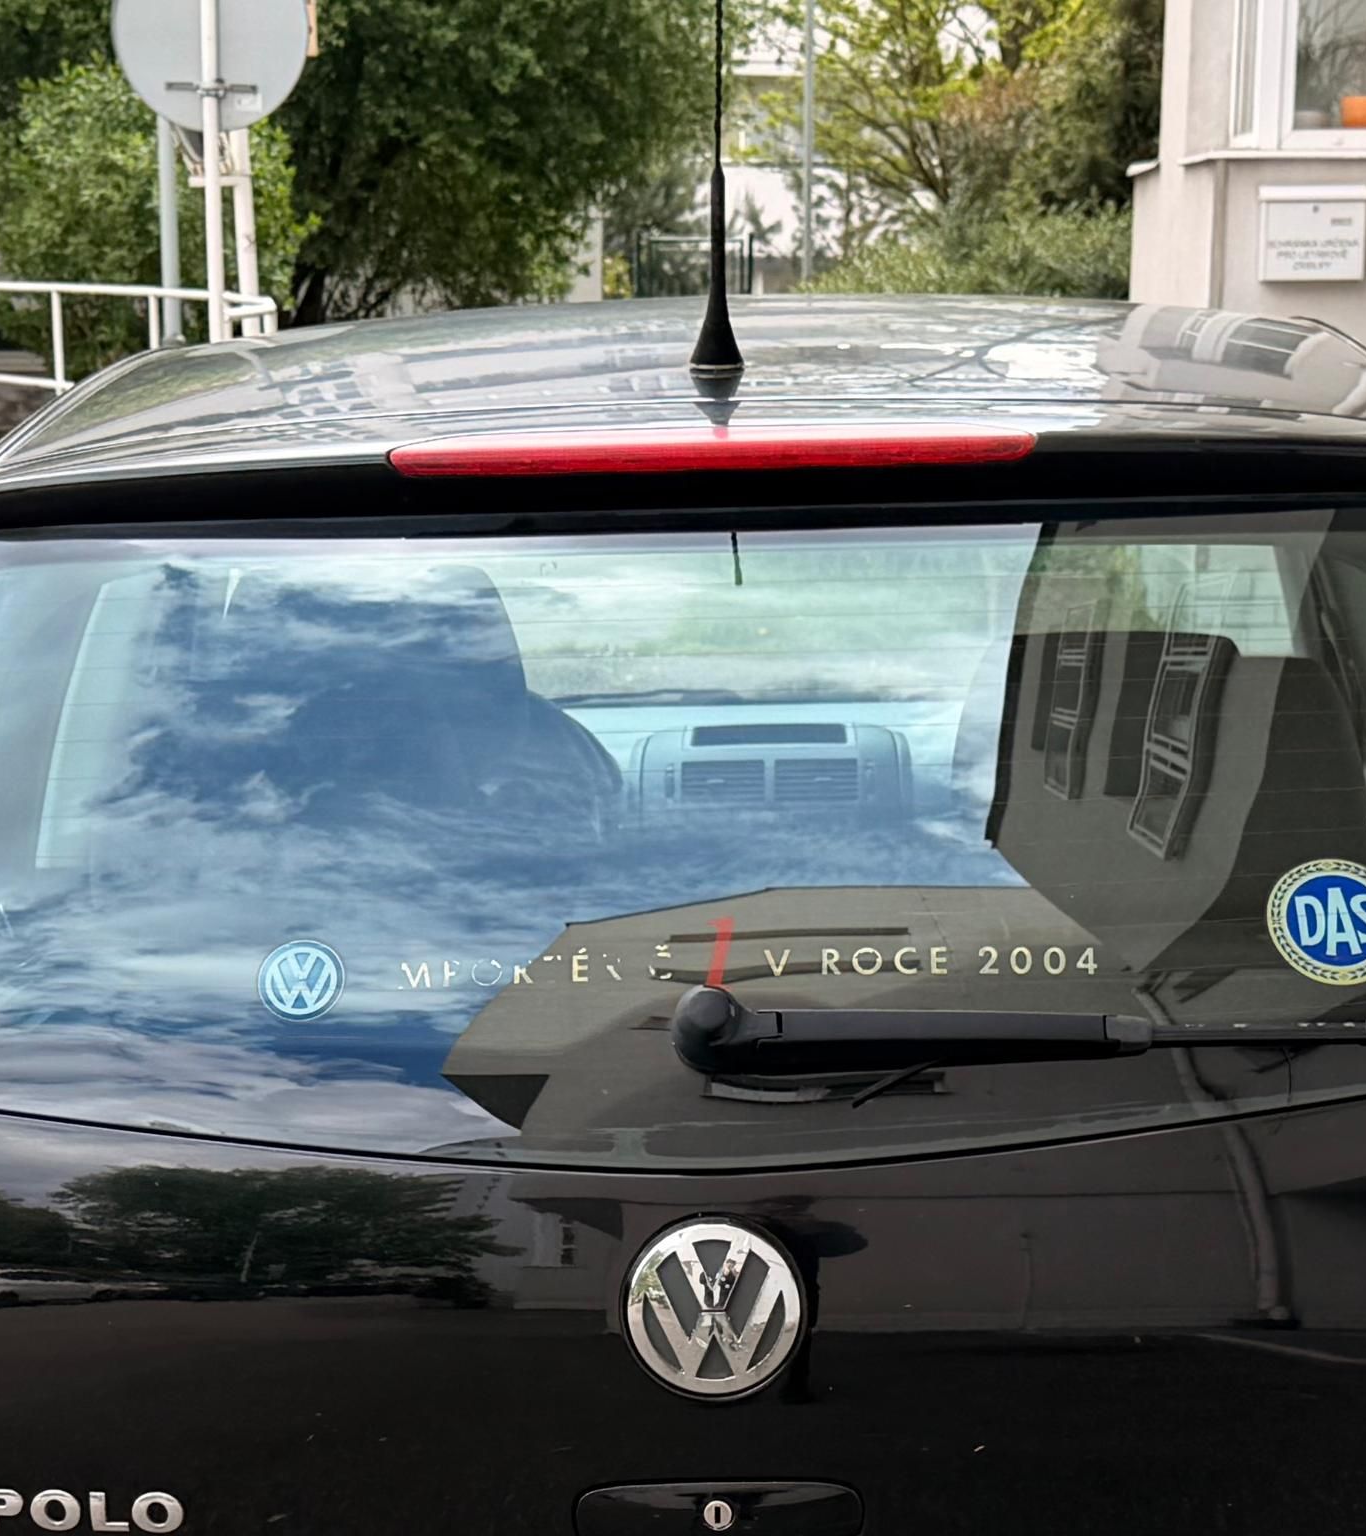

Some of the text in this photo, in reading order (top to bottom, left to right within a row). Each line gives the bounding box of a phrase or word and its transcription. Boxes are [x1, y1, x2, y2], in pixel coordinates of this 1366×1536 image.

[764, 948, 792, 977] V
[821, 945, 949, 976] ROCE
[978, 945, 1099, 976] 2004
